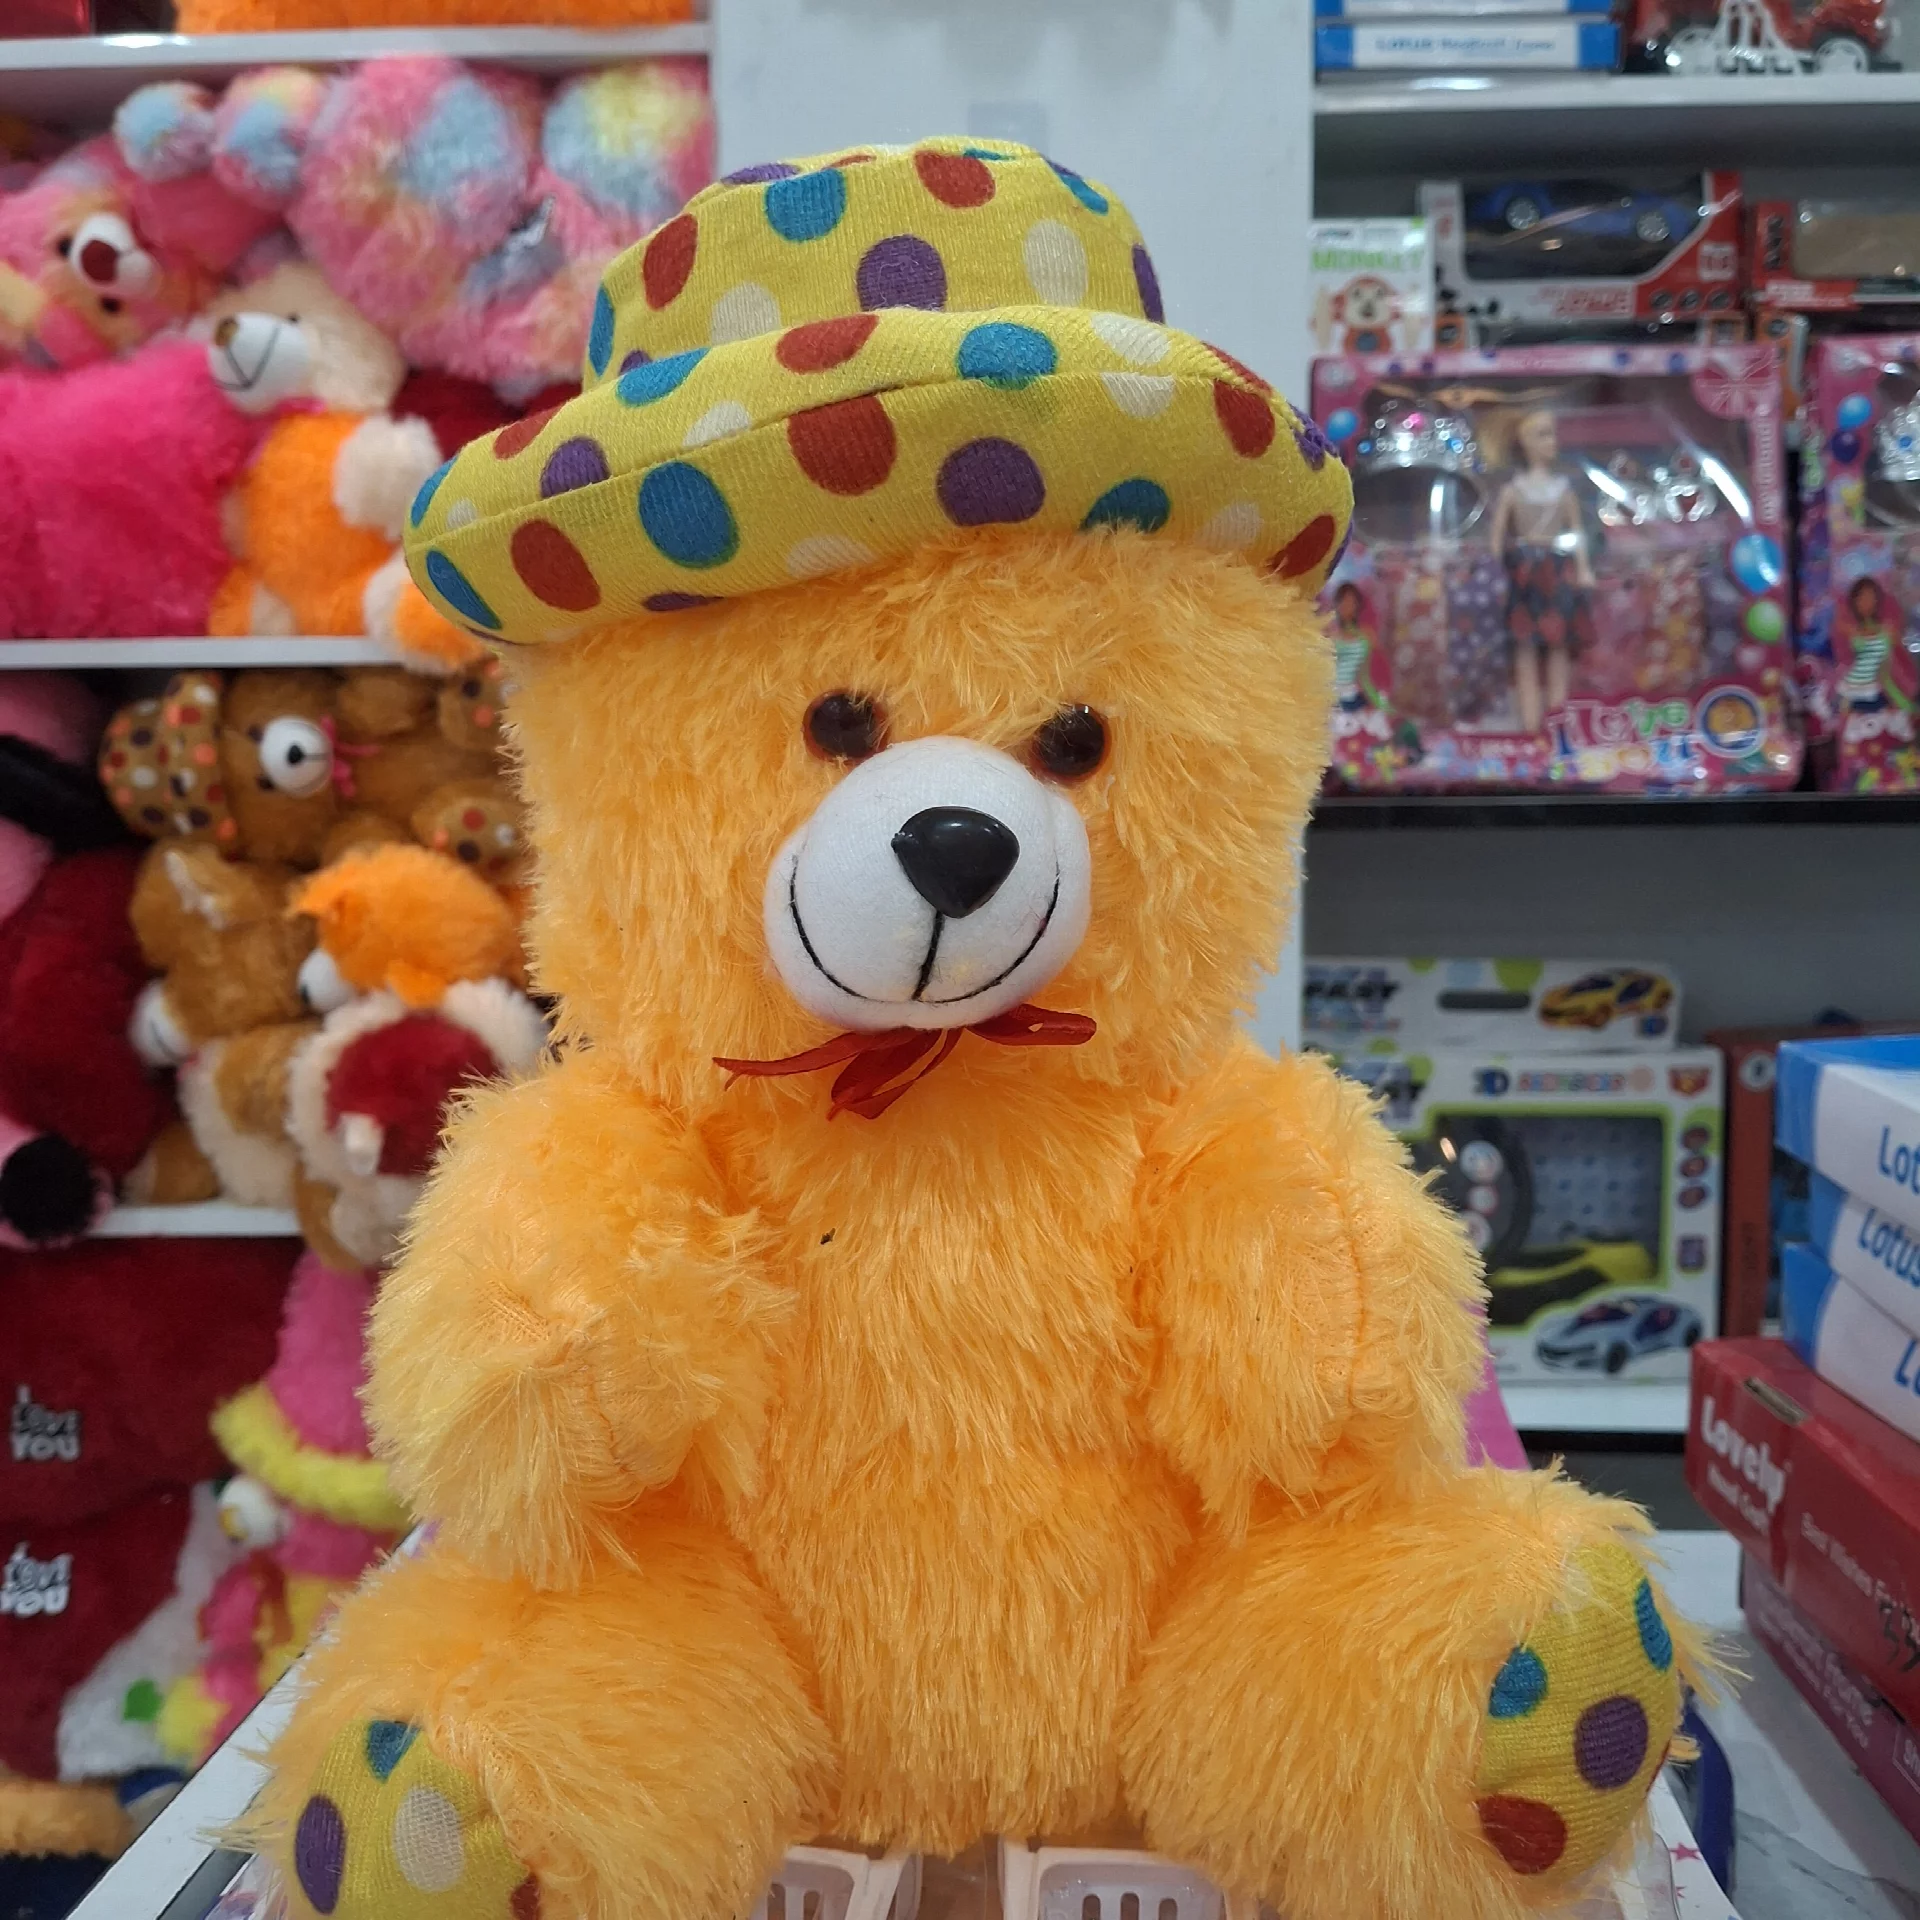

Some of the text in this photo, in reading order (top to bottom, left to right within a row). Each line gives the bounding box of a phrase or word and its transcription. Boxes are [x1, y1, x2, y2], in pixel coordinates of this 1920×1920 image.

[11, 1434, 81, 1462] YOU
[1702, 1395, 1786, 1515] Lovely
[0, 1586, 69, 1617] YOU
